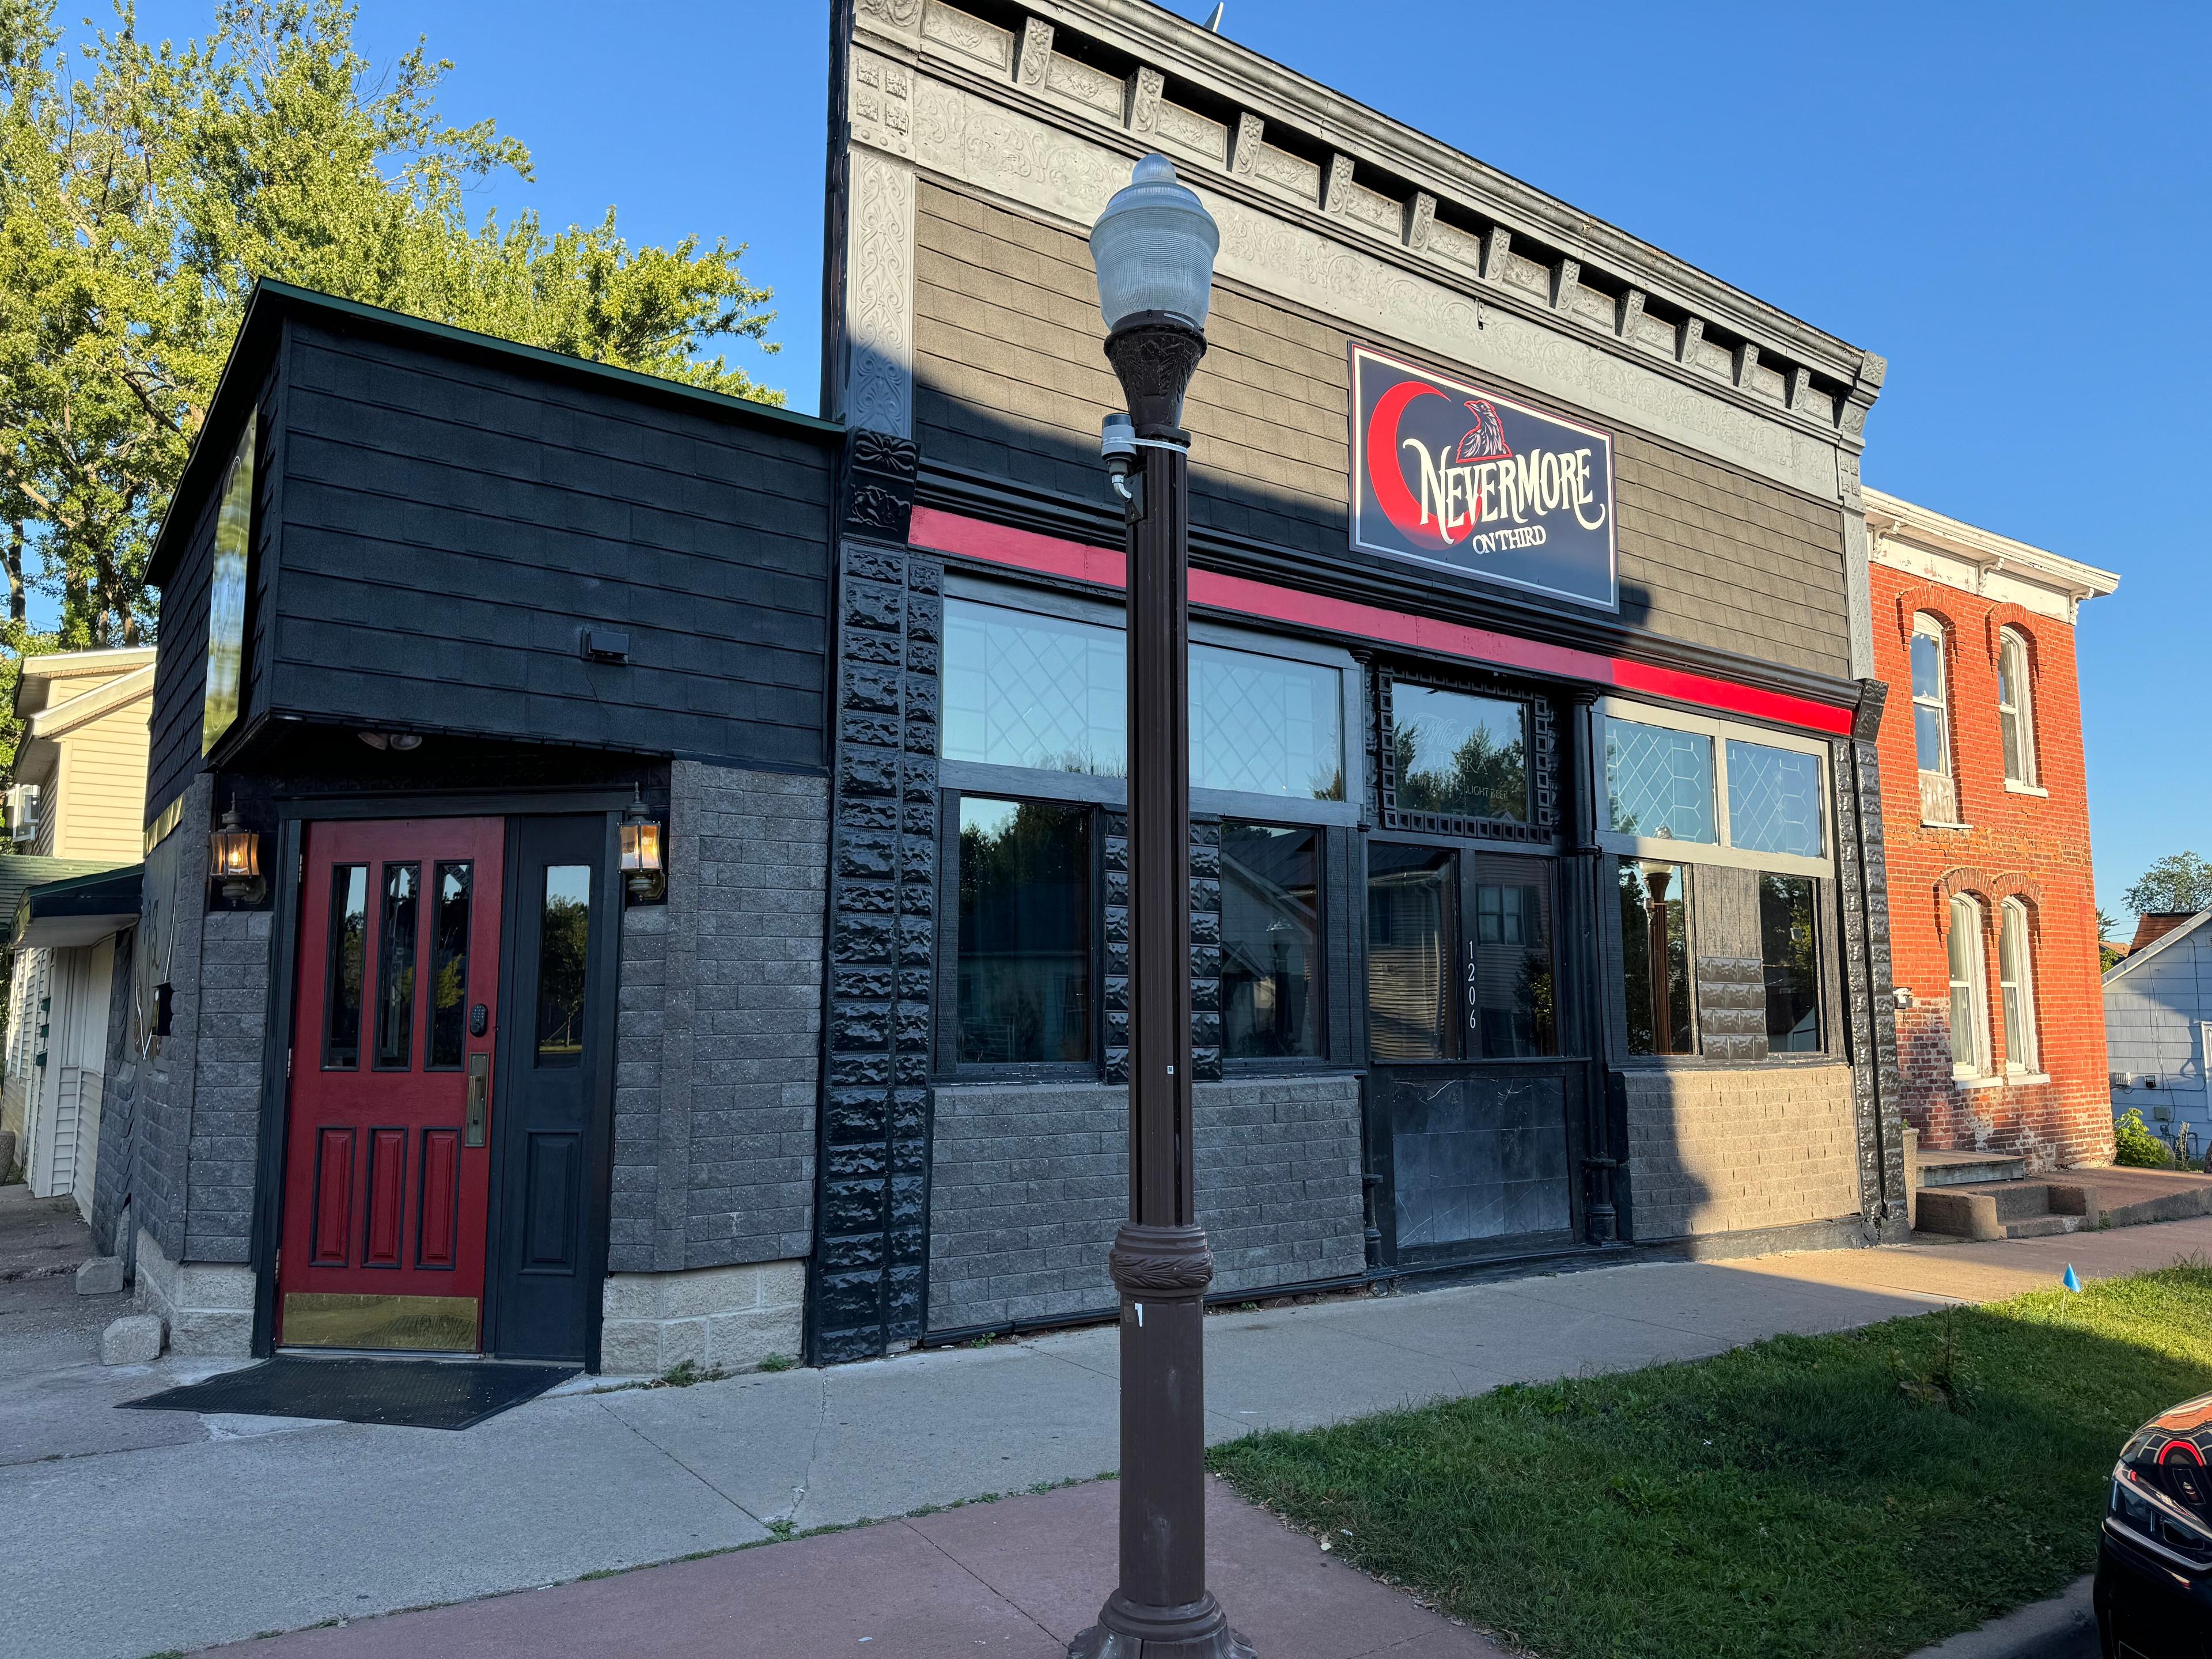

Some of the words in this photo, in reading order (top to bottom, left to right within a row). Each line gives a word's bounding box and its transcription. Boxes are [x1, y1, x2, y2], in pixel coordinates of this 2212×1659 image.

[1402, 438, 1605, 544] NEVERMORE
[1472, 532, 1496, 555] ON
[1495, 525, 1547, 551] THIRD
[1467, 785, 1489, 797] LIGHT
[1490, 789, 1508, 801] BEER
[1468, 940, 1476, 1029] 1206
